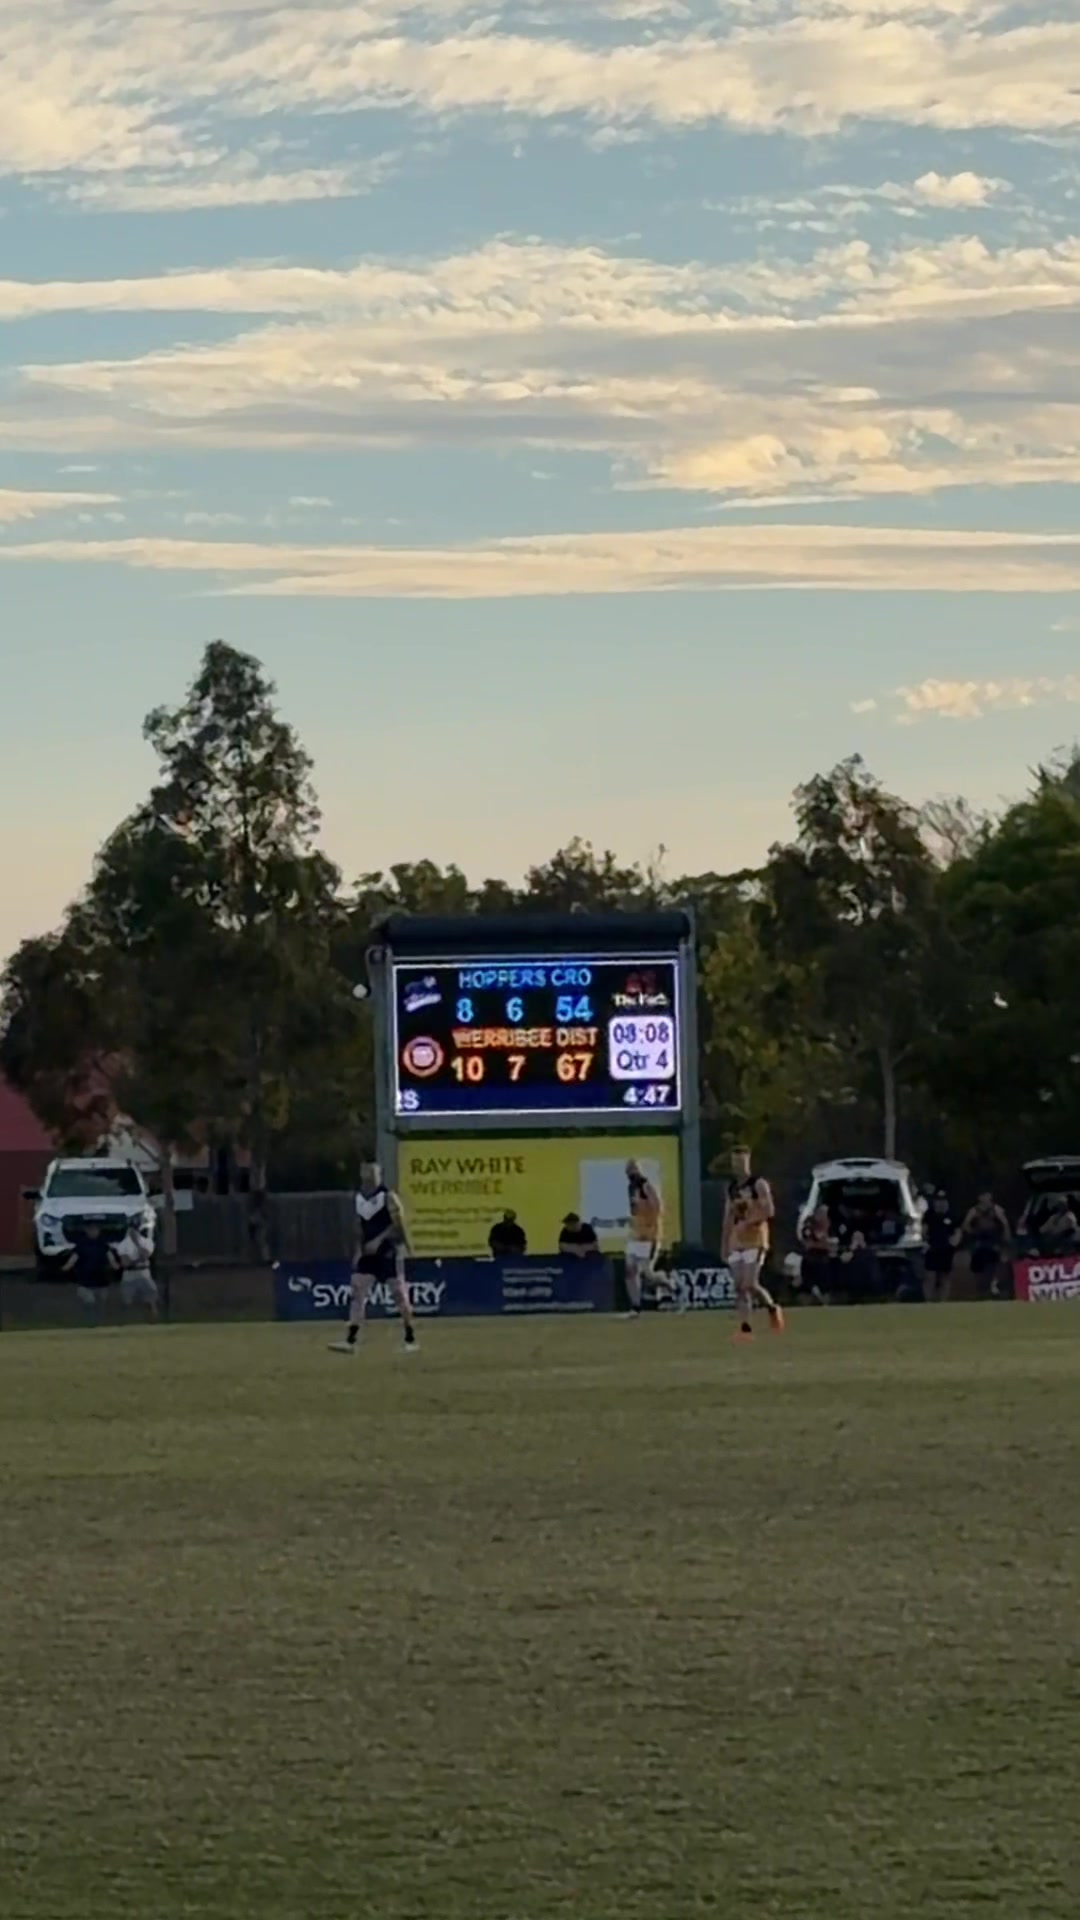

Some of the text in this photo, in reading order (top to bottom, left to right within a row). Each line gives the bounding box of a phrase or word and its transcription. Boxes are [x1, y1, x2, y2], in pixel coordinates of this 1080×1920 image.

[458, 967, 592, 989] HOPPERS CRO
[456, 997, 475, 1023] 8
[506, 997, 524, 1022] 6
[556, 994, 594, 1022] 54
[452, 1026, 598, 1048] WERRIBEE DIST
[613, 1021, 670, 1044] 08:08
[451, 1053, 594, 1082] 10 7 67
[616, 1048, 669, 1071] Qtr 4
[623, 1084, 670, 1105] 4:47
[410, 1155, 526, 1176] RAY WHITE
